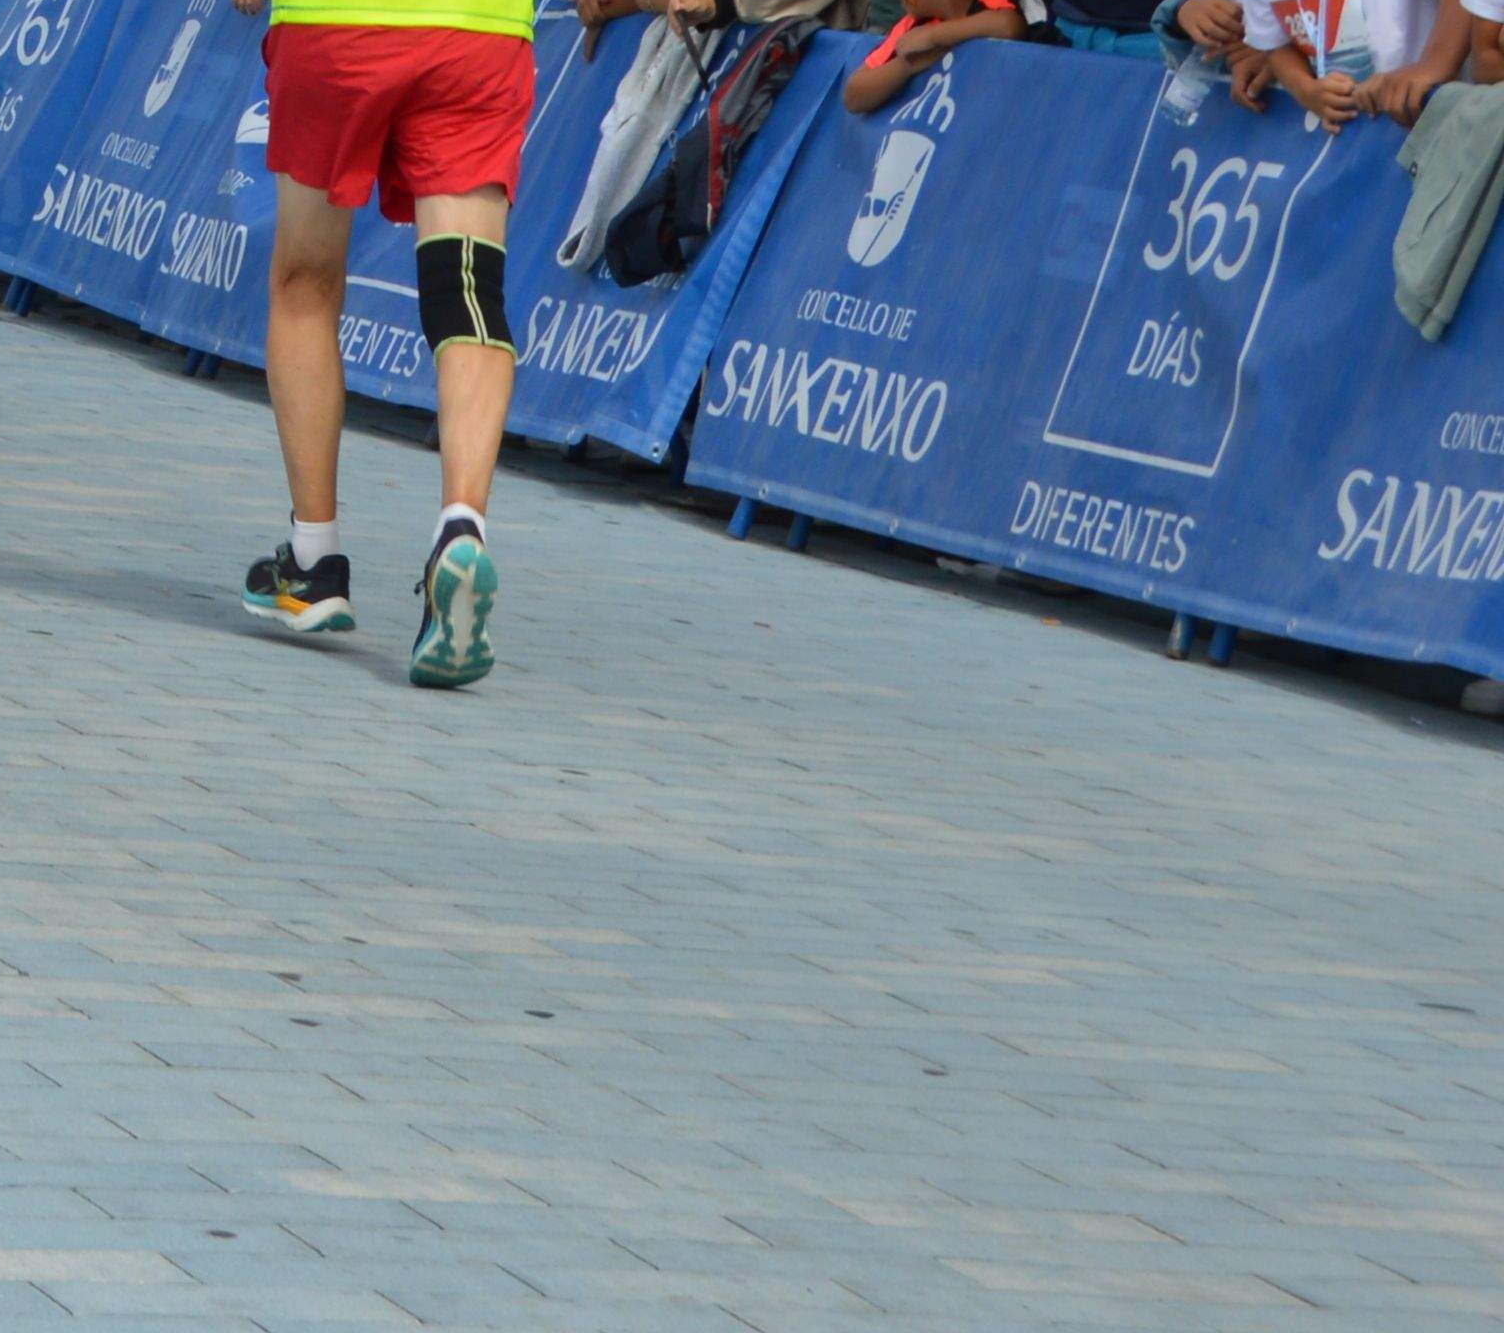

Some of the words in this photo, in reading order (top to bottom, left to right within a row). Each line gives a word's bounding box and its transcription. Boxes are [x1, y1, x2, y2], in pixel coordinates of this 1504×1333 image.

[33, 163, 167, 262] SANXENXO
[1144, 148, 1286, 281] 365
[796, 288, 890, 335] CONCELLO
[886, 307, 918, 341] DE
[1126, 310, 1204, 387] DÍAS
[707, 339, 949, 463] SANXENXO
[1011, 480, 1195, 574] DIFERENTES
